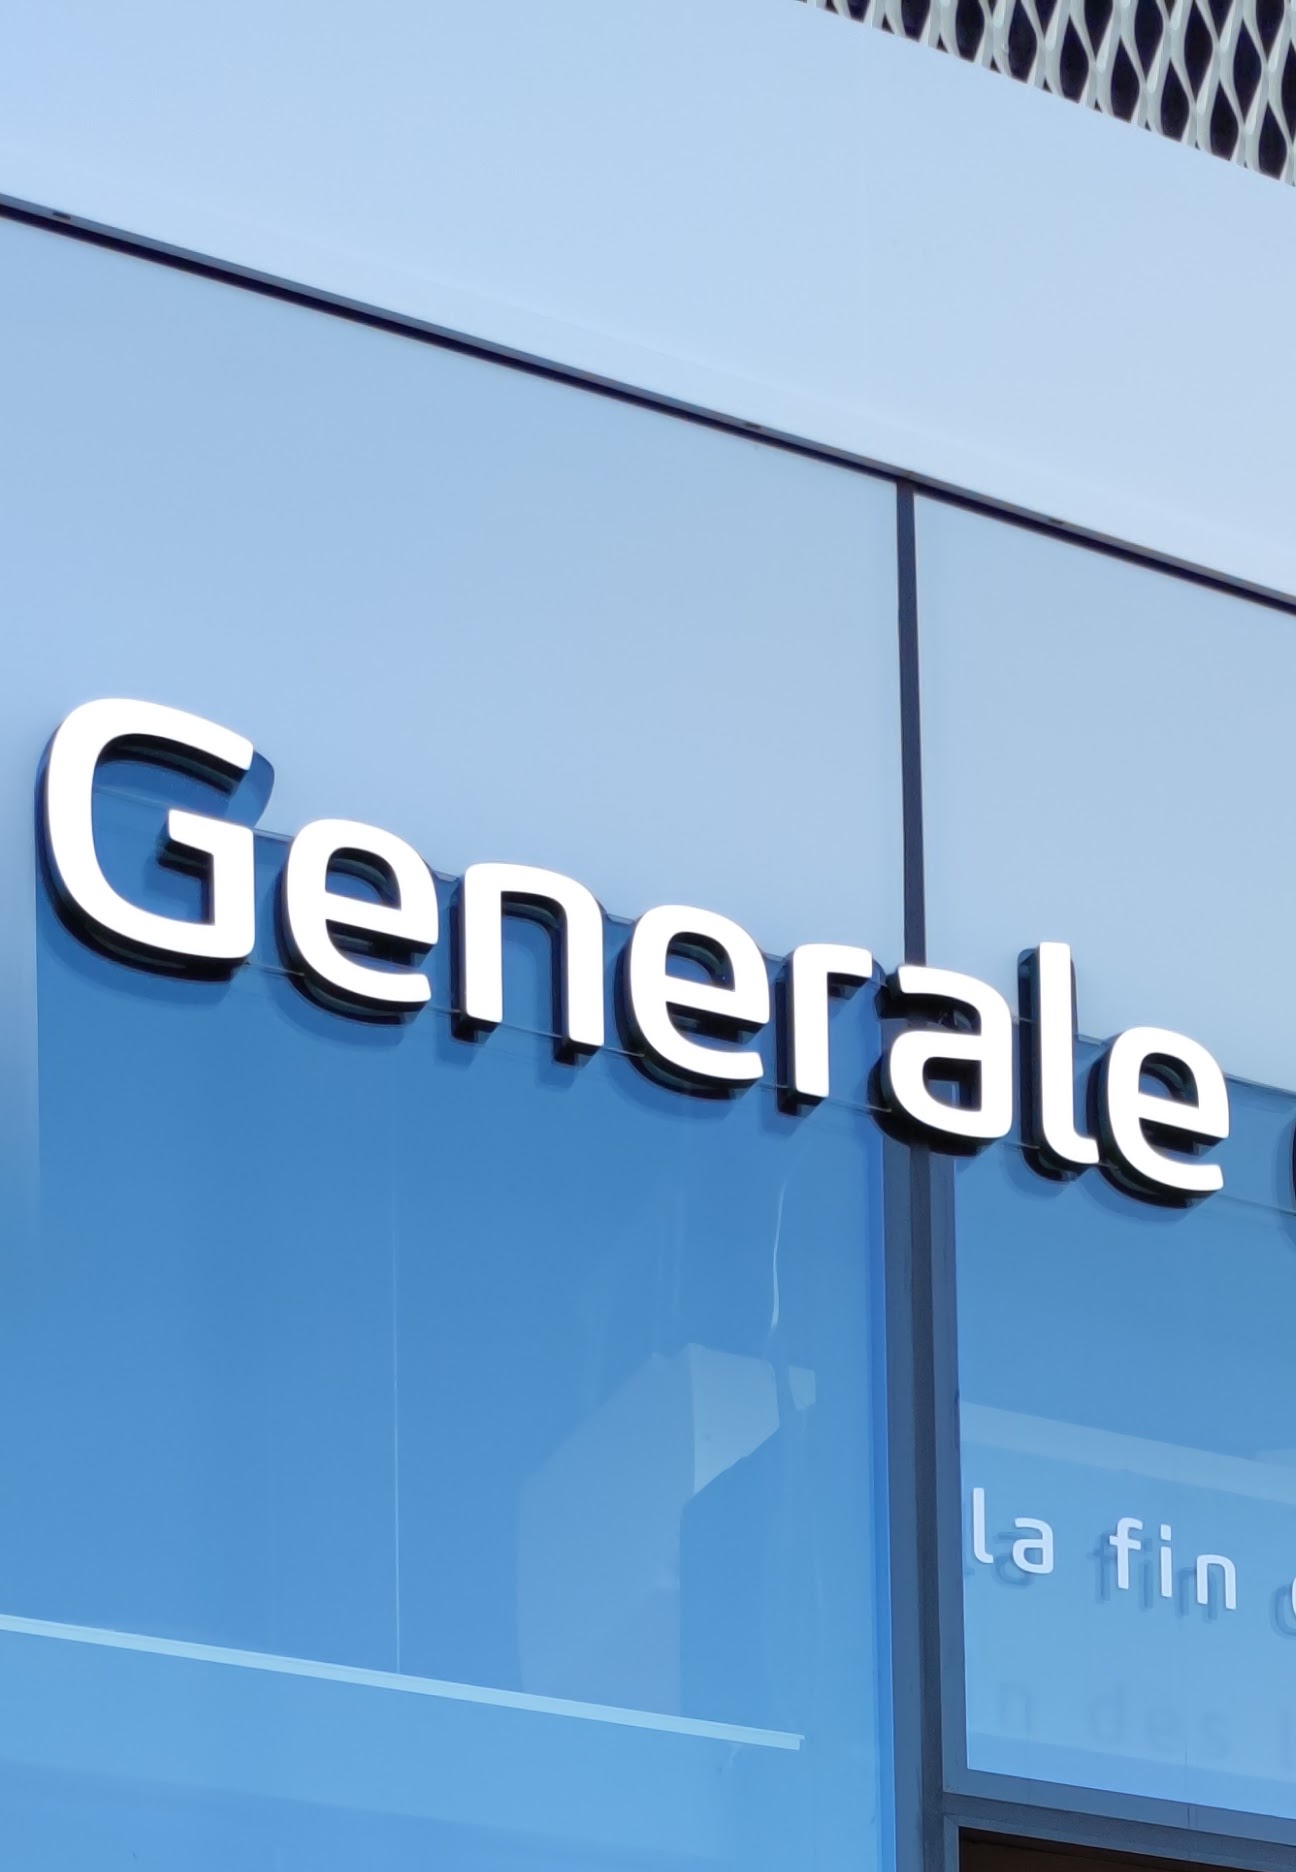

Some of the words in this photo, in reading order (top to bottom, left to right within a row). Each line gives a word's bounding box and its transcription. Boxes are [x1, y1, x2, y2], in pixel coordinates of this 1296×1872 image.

[43, 697, 1231, 1196] Generale
[970, 1486, 1054, 1575] la
[1109, 1517, 1238, 1611] fin
